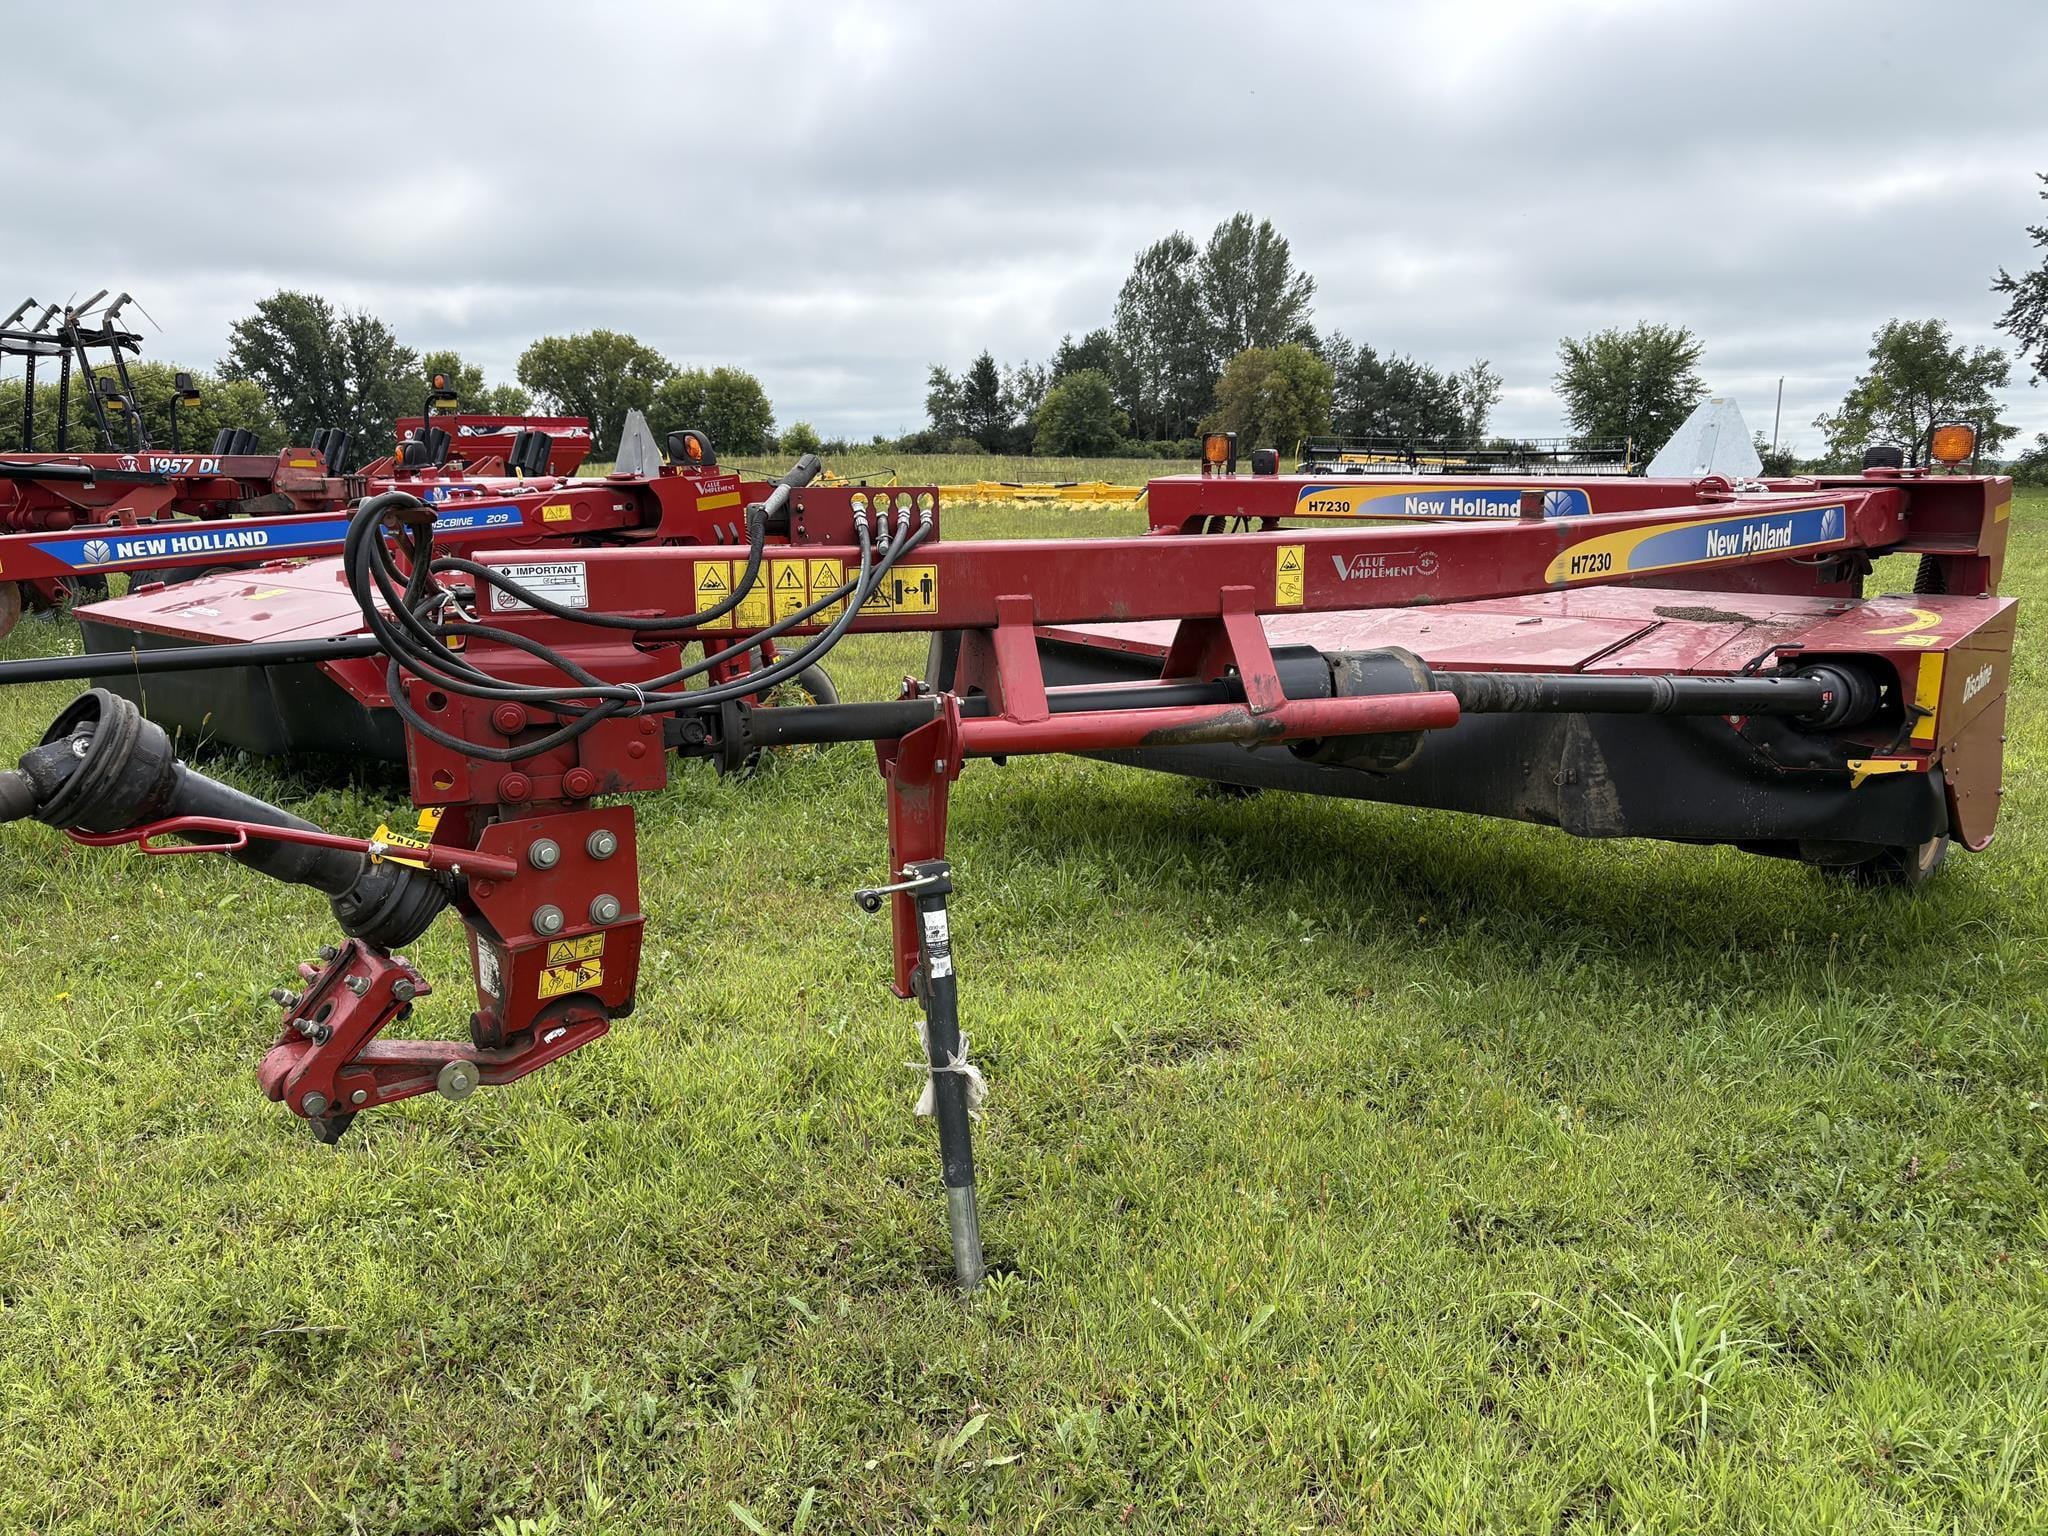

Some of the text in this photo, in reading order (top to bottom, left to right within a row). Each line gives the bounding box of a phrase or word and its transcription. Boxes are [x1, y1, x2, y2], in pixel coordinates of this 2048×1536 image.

[1308, 497, 1521, 517] H7230 New Holland
[432, 513, 509, 529] ISCBINE 209
[116, 530, 268, 559] NEW HOLLAND
[1706, 520, 1793, 558] New Holland
[516, 565, 578, 575] IMPORTANT
[1331, 555, 1386, 581] VALUE
[1350, 565, 1416, 580] IMPLEMENT
[1571, 552, 1612, 575] H7230
[1962, 663, 1993, 705] Discbine
